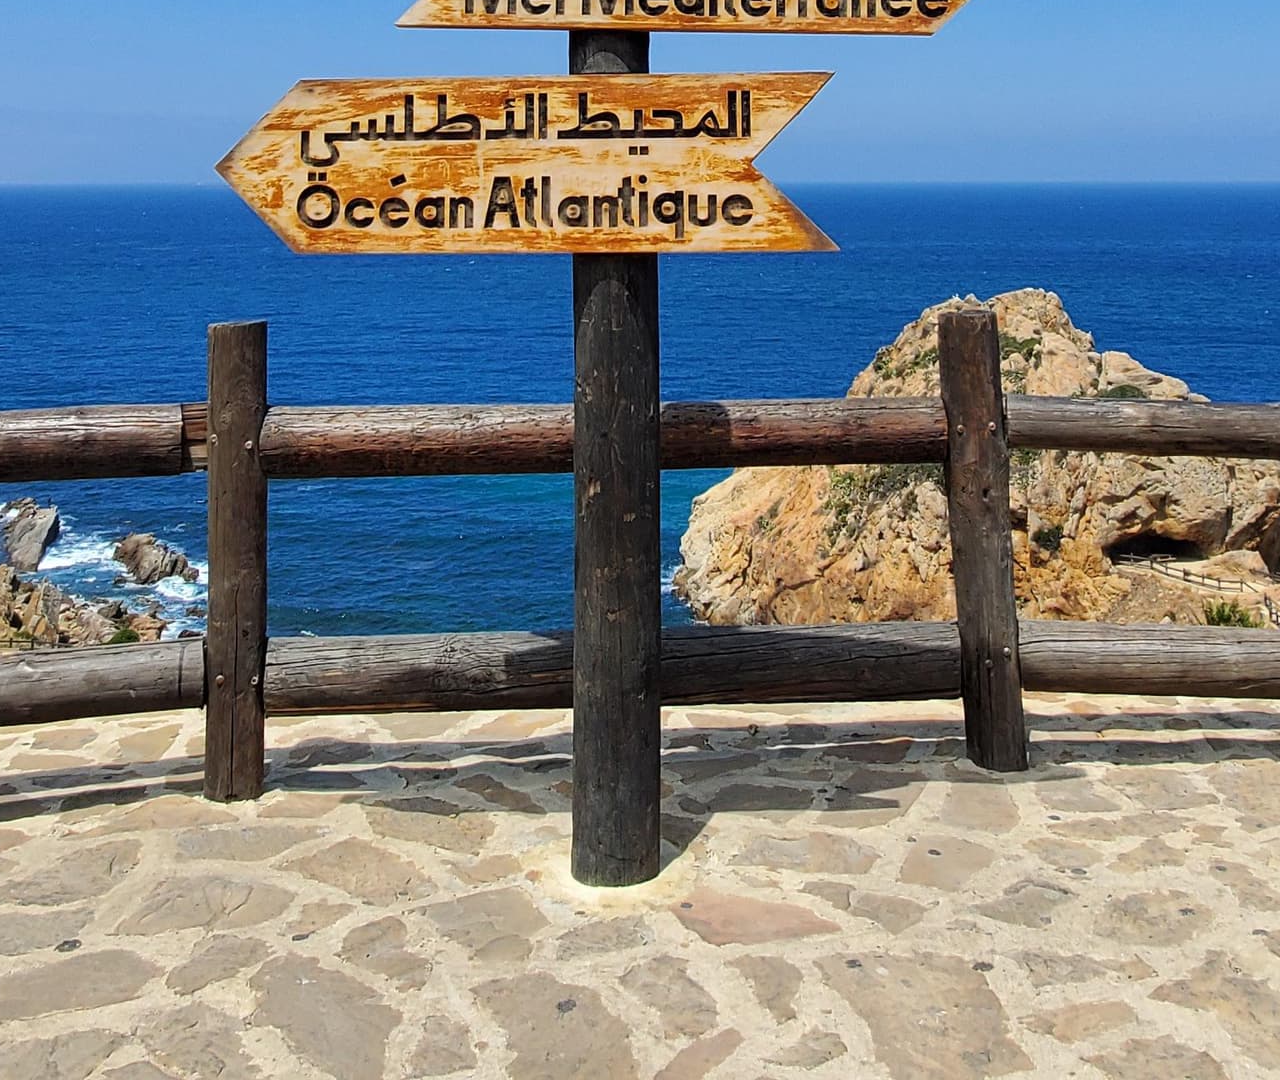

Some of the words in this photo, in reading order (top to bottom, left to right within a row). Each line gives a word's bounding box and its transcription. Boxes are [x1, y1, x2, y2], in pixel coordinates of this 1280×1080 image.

[299, 92, 549, 183] الأطلسي
[556, 89, 752, 157] المحيط
[295, 173, 475, 230] Océan
[483, 174, 755, 240] Atlantique
